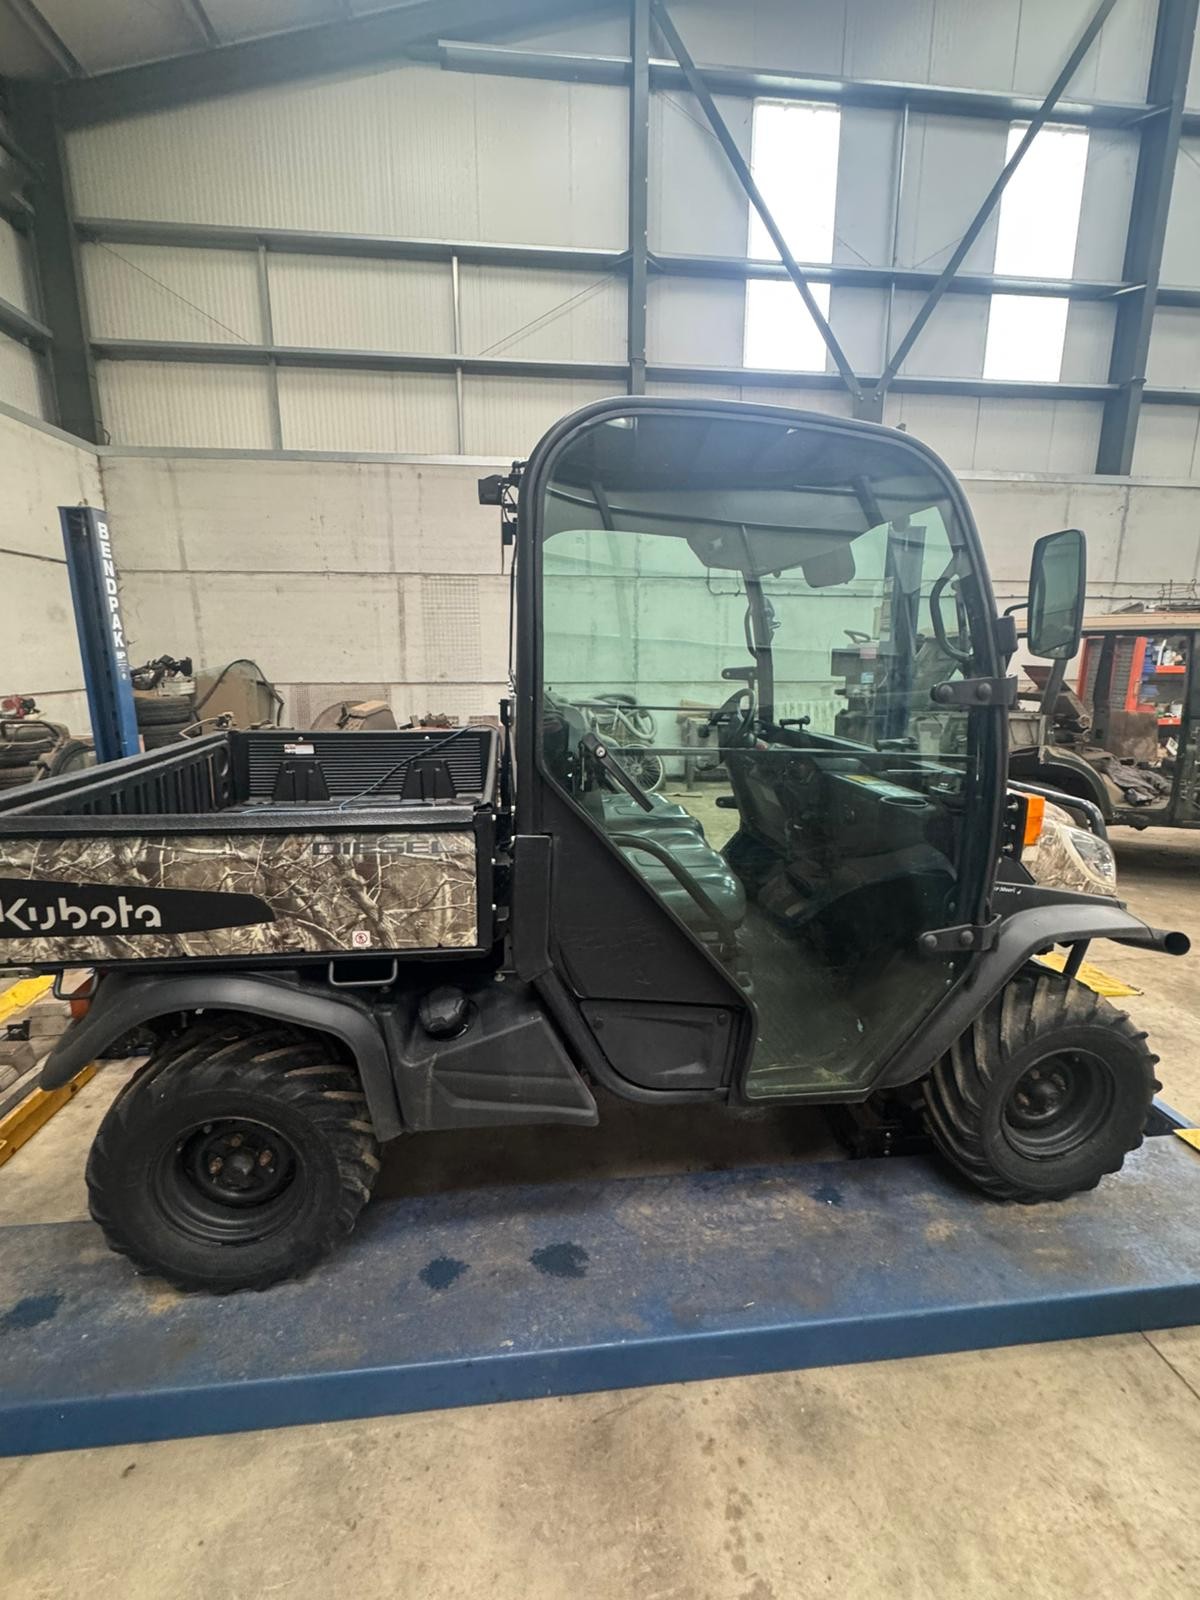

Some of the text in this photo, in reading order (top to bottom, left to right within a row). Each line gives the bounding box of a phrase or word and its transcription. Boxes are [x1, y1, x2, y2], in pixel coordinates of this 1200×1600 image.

[97, 521, 125, 648] BENDPAK
[312, 840, 458, 855] DIESEL
[0, 896, 162, 931] Kubota
